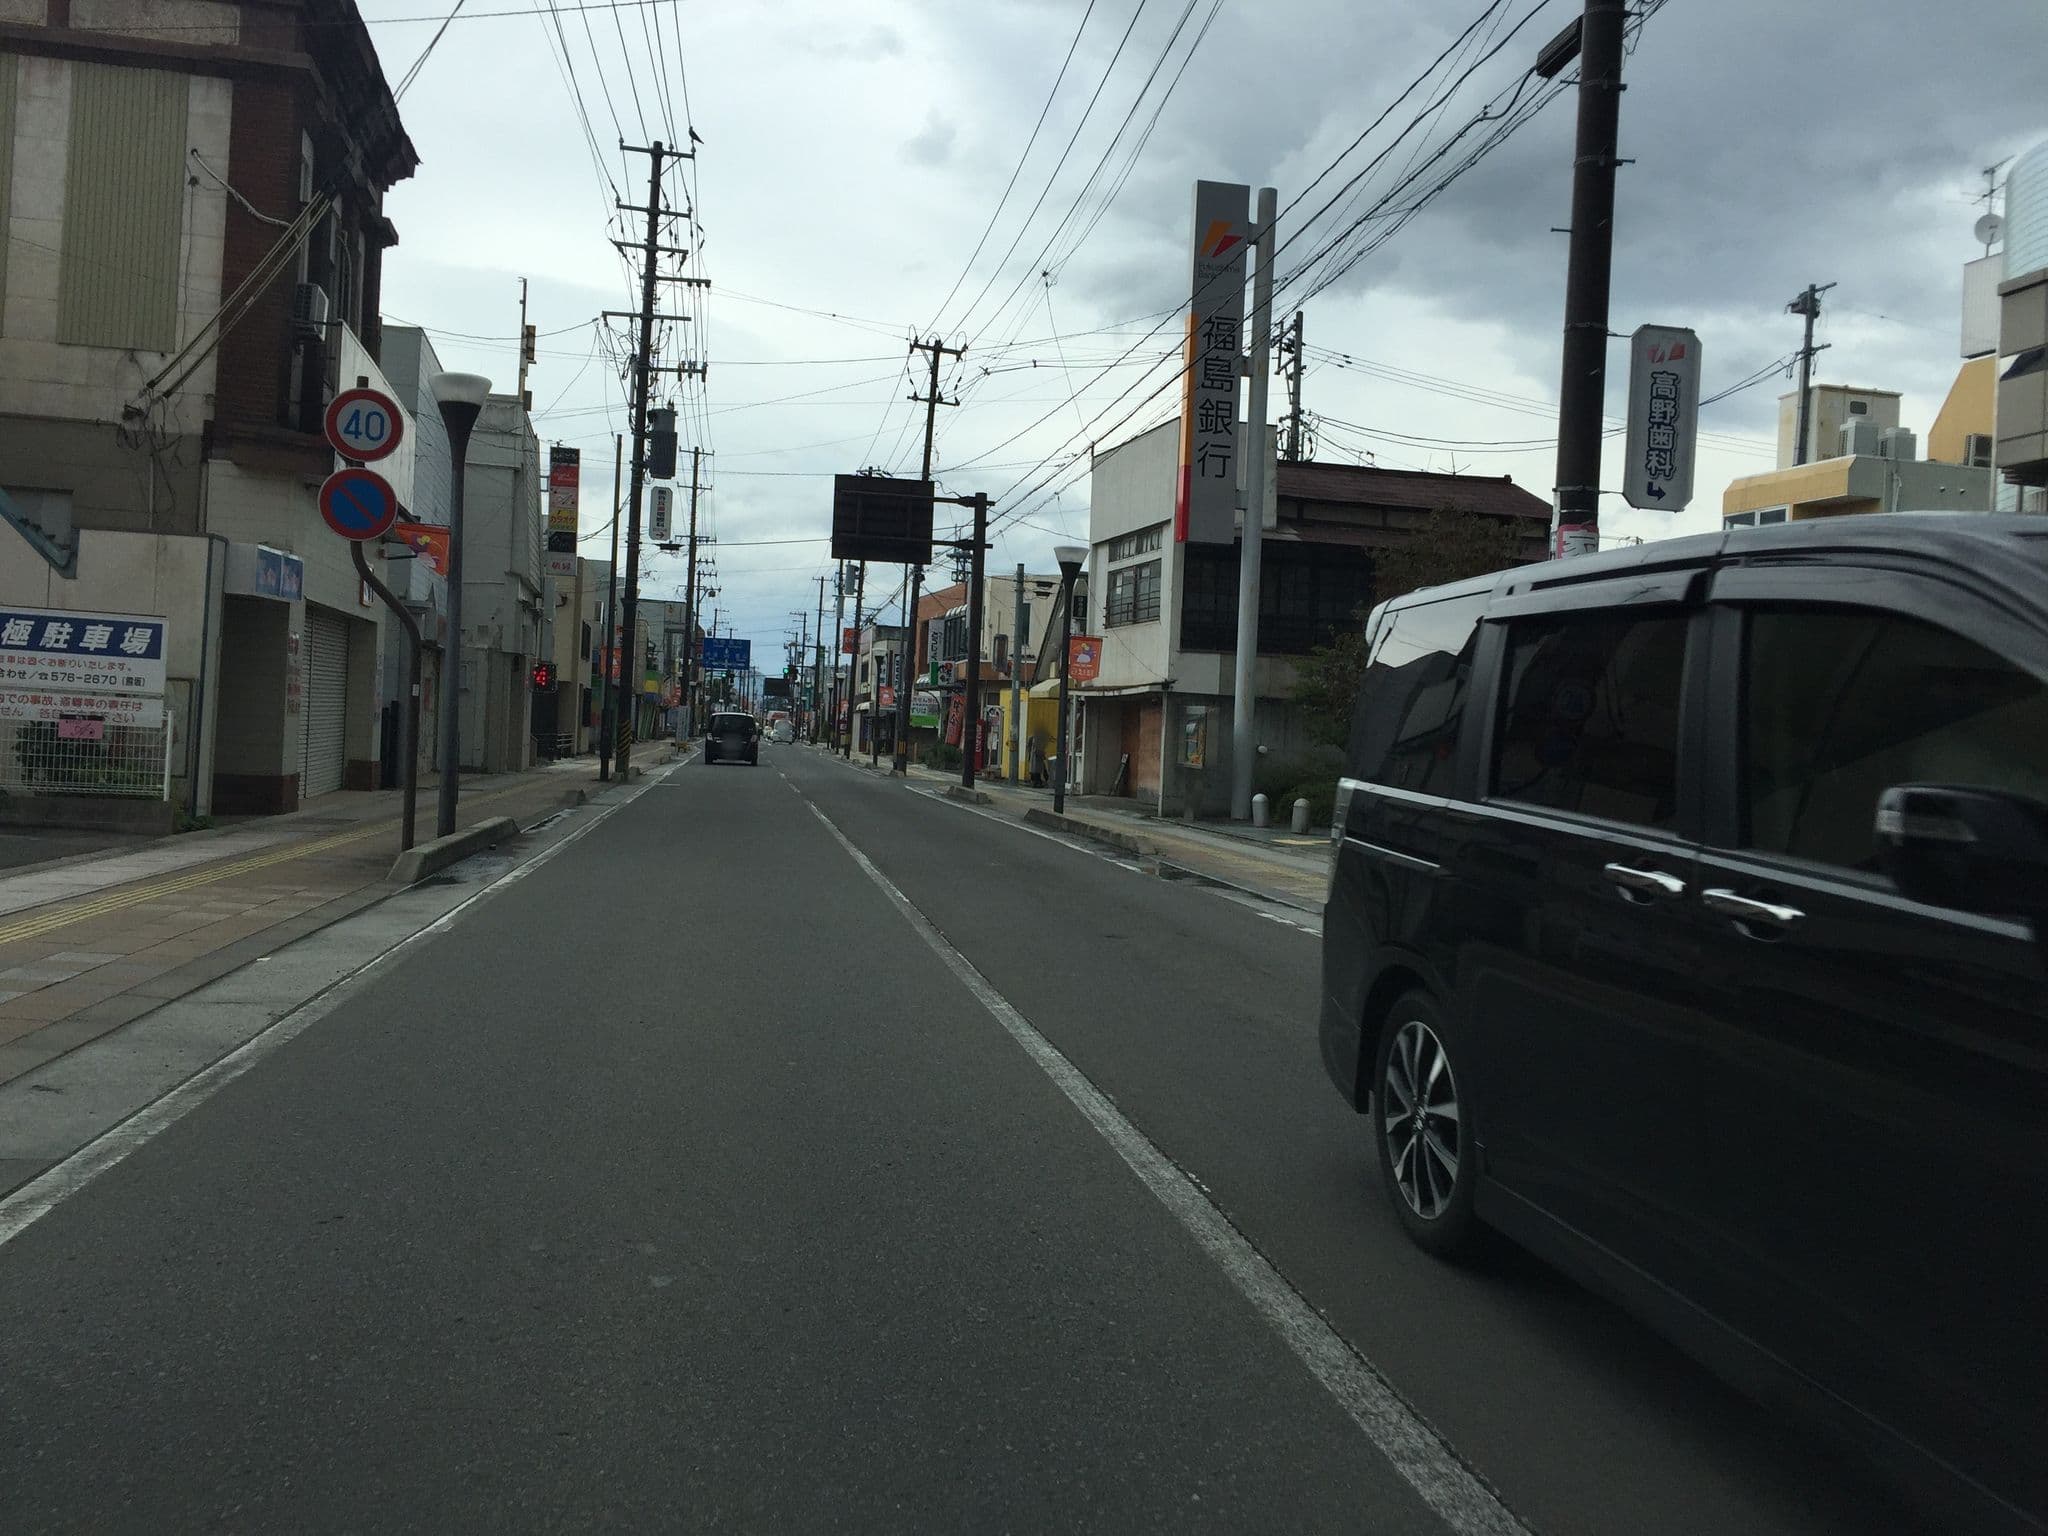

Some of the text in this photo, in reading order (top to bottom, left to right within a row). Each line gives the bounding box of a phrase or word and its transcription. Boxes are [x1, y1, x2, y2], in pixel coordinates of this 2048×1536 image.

[343, 409, 385, 442] 40
[1197, 315, 1238, 479] 福島銀行
[1645, 370, 1681, 480] 高野歯科
[0, 617, 153, 655] 極駐車場
